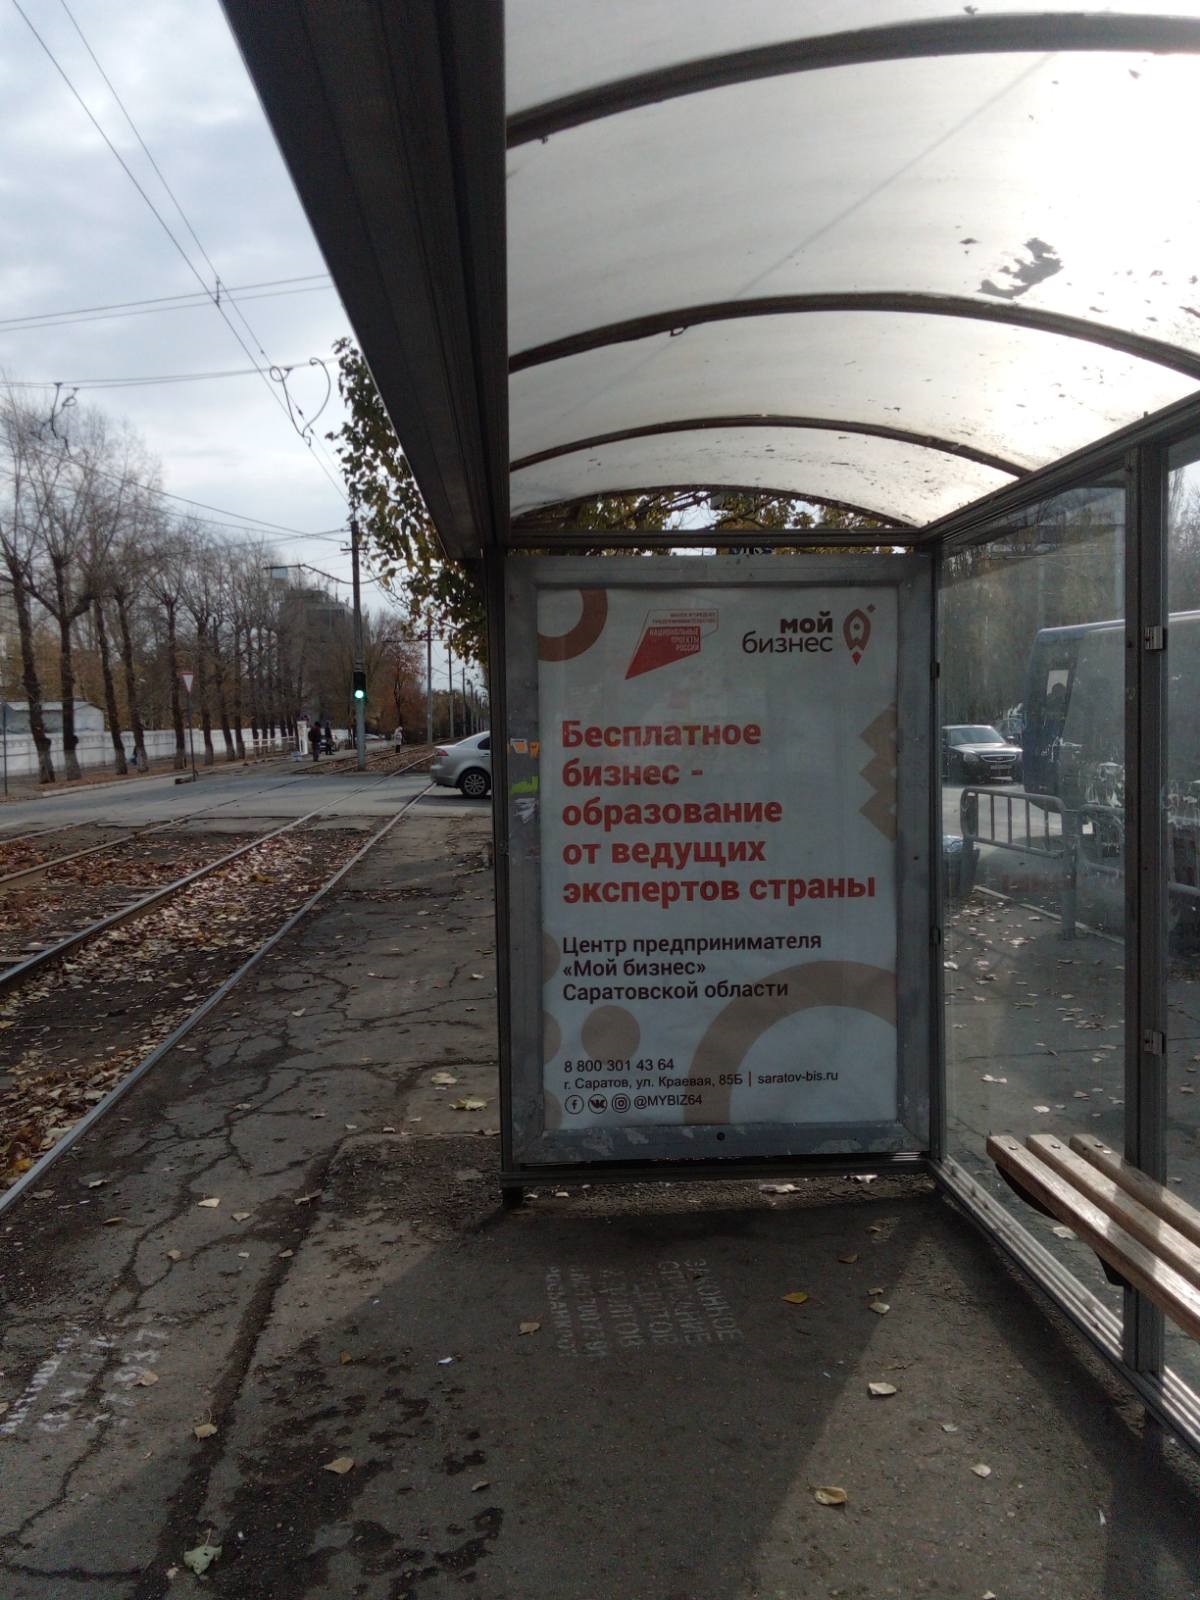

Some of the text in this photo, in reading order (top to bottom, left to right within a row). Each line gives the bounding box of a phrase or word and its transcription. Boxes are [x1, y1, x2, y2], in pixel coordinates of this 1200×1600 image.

[780, 611, 833, 632] мой
[742, 630, 833, 654] бизнес
[561, 720, 762, 748] Бесплатное
[562, 757, 680, 787] бизнес
[562, 798, 782, 832] образование
[562, 840, 766, 869] от ведущих
[562, 876, 875, 909] экспертов страны
[563, 934, 822, 957] Центр предпринимателя
[563, 958, 706, 977] «Мой бизнес»
[562, 980, 789, 1004] Саратовской области
[564, 1057, 675, 1073] 8 800 301 43 64
[574, 1077, 632, 1092] Саратов,
[636, 1077, 654, 1090] ул.
[658, 1075, 715, 1089] Краевая,
[718, 1073, 744, 1086] 85Б
[757, 1069, 839, 1085] saratov-bis.ru
[634, 1094, 703, 1110] @MYBIZ64
